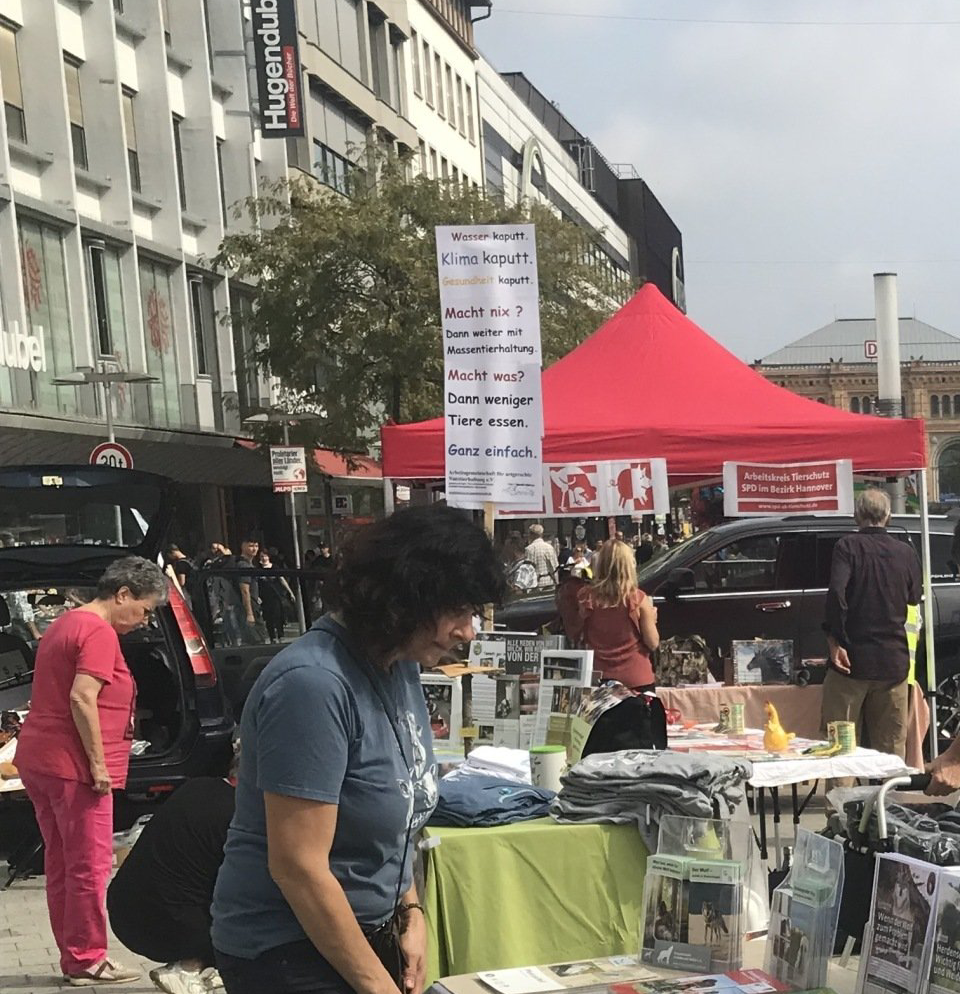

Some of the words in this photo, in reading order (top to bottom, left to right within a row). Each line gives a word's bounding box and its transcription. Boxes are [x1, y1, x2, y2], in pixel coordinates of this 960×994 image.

[451, 232, 489, 242] Wasser
[492, 231, 529, 243] kaputt.
[441, 252, 479, 266] Klima
[482, 250, 534, 268] kaputt.
[441, 275, 495, 287] Gesundheit
[498, 275, 534, 287] kaputt.
[445, 306, 486, 319] Macht
[490, 306, 511, 318] nix
[515, 305, 524, 317] ?
[445, 329, 469, 339] Dann
[472, 328, 504, 338] weiter
[507, 328, 523, 337] mit
[0, 320, 47, 372] ubel
[447, 343, 538, 355] Massentierhaltung.
[447, 369, 488, 382] Macht
[493, 370, 525, 382] was?
[447, 391, 480, 405] Dann
[484, 394, 534, 409] weniger
[447, 414, 483, 427] Tiere
[488, 417, 529, 428] essen.
[448, 443, 480, 457] Ganz
[485, 445, 538, 459] einfach.
[743, 472, 791, 482] Arbeitskreis
[791, 471, 830, 481] Tierschutz
[741, 483, 757, 492] SPD
[758, 485, 769, 493] im
[770, 485, 796, 493] Bezirk
[795, 483, 833, 493] Hannover
[506, 651, 523, 662] VON
[524, 652, 539, 662] DER
[935, 953, 957, 972] Wichtig
[933, 966, 946, 977] und
